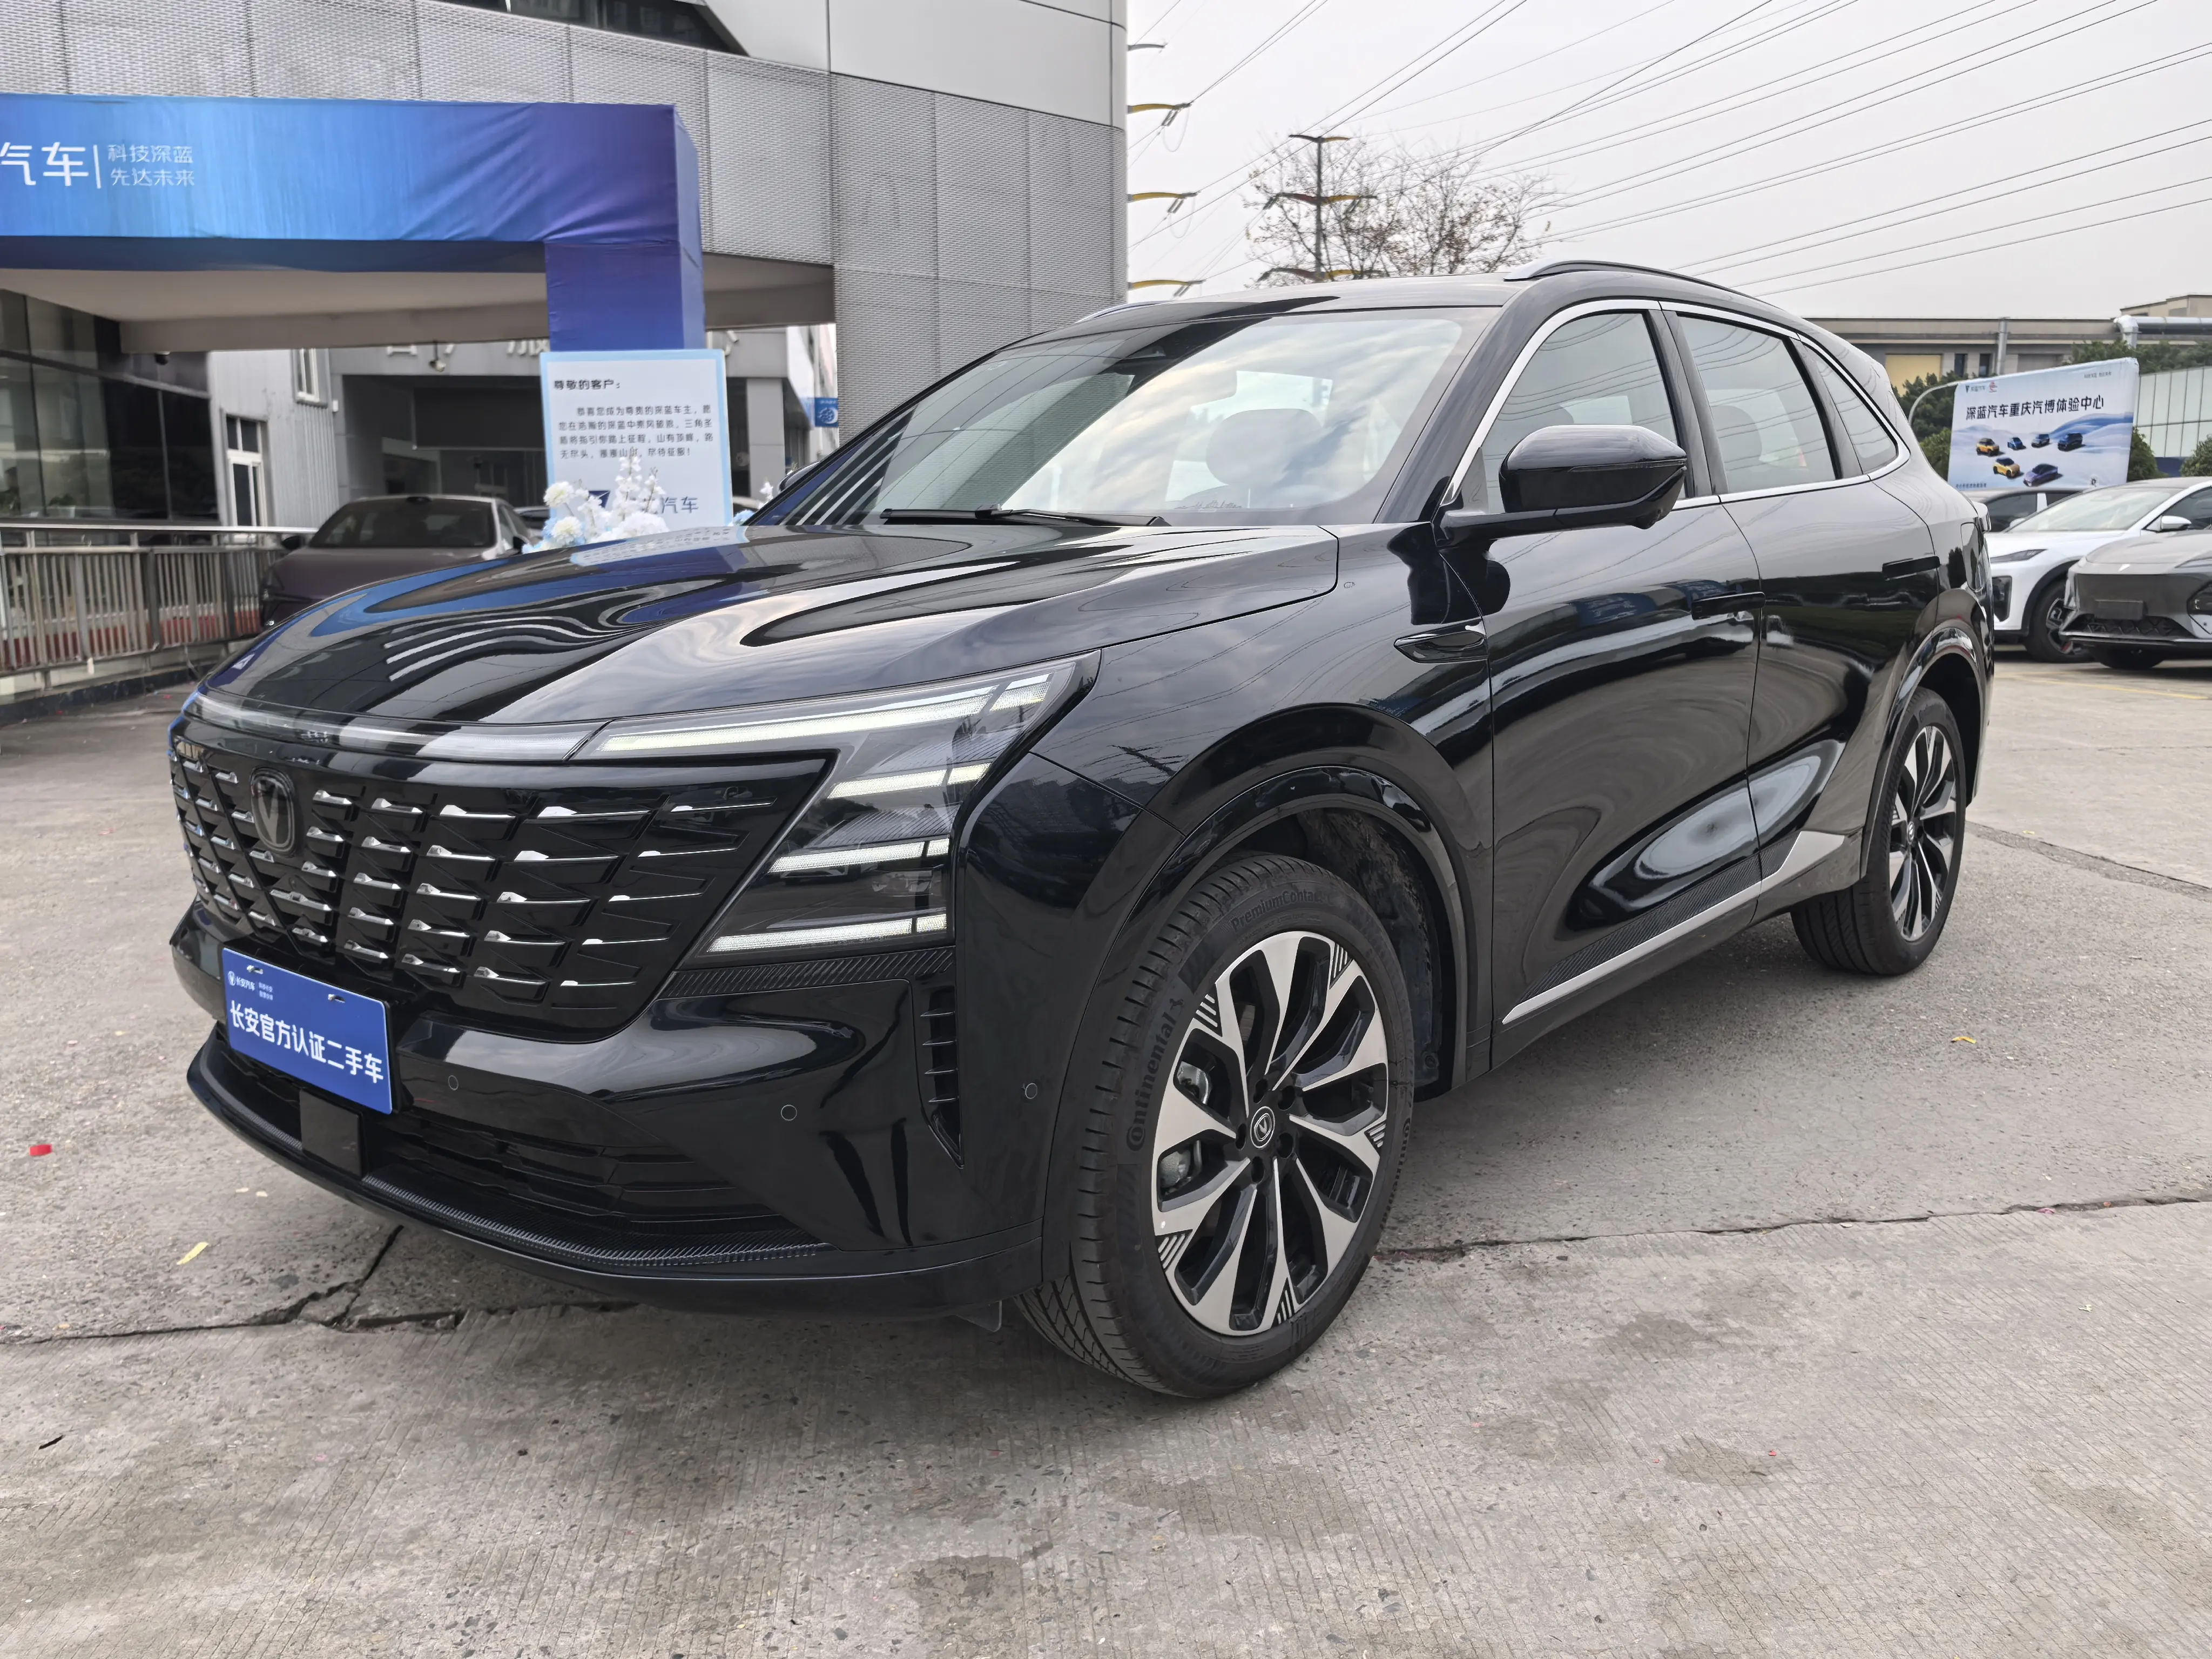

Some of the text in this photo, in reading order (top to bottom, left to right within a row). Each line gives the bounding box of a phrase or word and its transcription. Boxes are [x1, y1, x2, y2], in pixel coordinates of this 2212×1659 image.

[0, 141, 89, 186] 汽车
[108, 144, 193, 164] 科技深蓝
[110, 168, 195, 187] 先达未来
[554, 379, 621, 390] 尊敬的客户:
[1966, 394, 2104, 420] 深蓝汽车重庆汽博体验中心
[230, 1000, 384, 1084] 长安官方认证二手车
[1125, 1011, 1177, 1151] Continental
